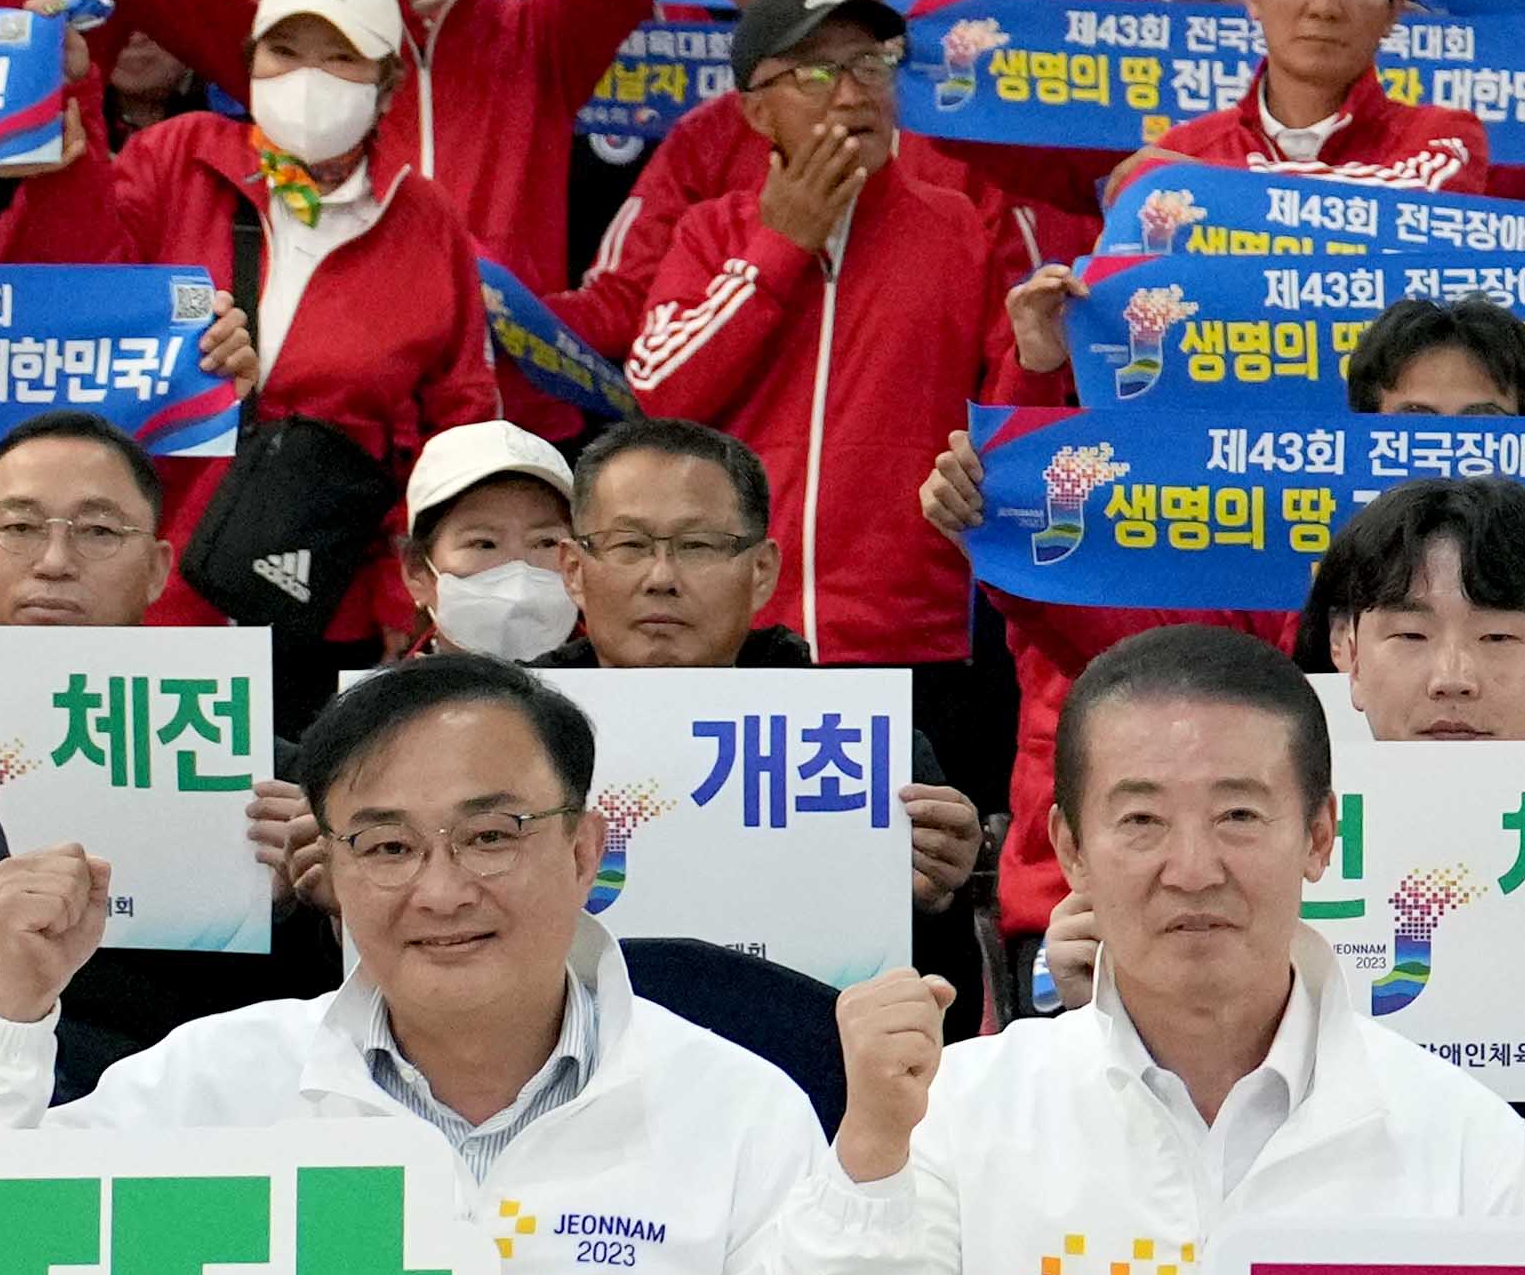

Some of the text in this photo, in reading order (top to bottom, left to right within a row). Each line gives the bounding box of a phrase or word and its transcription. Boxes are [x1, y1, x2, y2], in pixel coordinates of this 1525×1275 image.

[1207, 429, 1344, 475] 제43회
[1104, 484, 1264, 549] 생명의
[1283, 488, 1336, 552] 땅
[51, 674, 252, 792] 체전
[691, 714, 890, 828] 개최
[1335, 943, 1387, 955] EONNAM
[1356, 957, 1386, 969] 2023
[554, 1214, 665, 1253] JEONNAM
[577, 1241, 635, 1266] 2023
